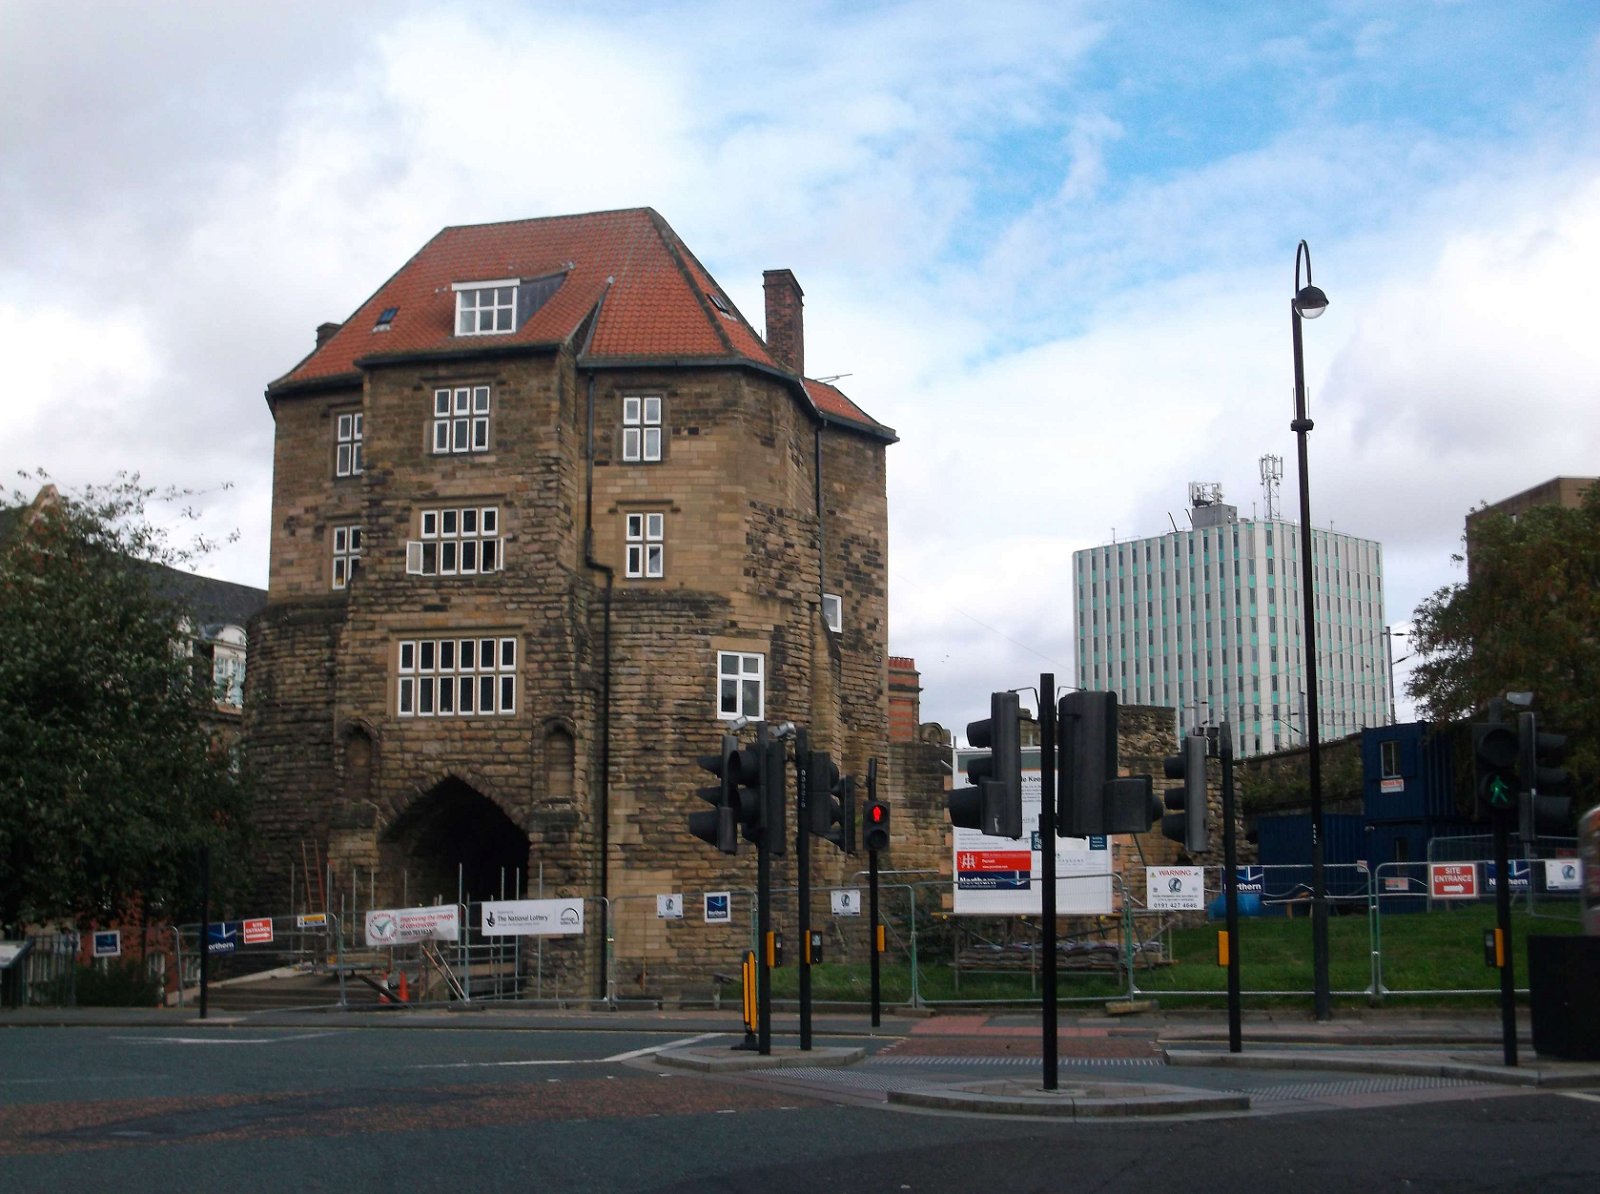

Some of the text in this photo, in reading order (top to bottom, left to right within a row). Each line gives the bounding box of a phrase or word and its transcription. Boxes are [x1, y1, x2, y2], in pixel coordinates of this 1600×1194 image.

[1445, 867, 1460, 875] SITE
[1434, 875, 1472, 883] ENTRANCE
[508, 914, 529, 922] National
[530, 913, 548, 922] Lottery
[207, 941, 235, 951] orthern
